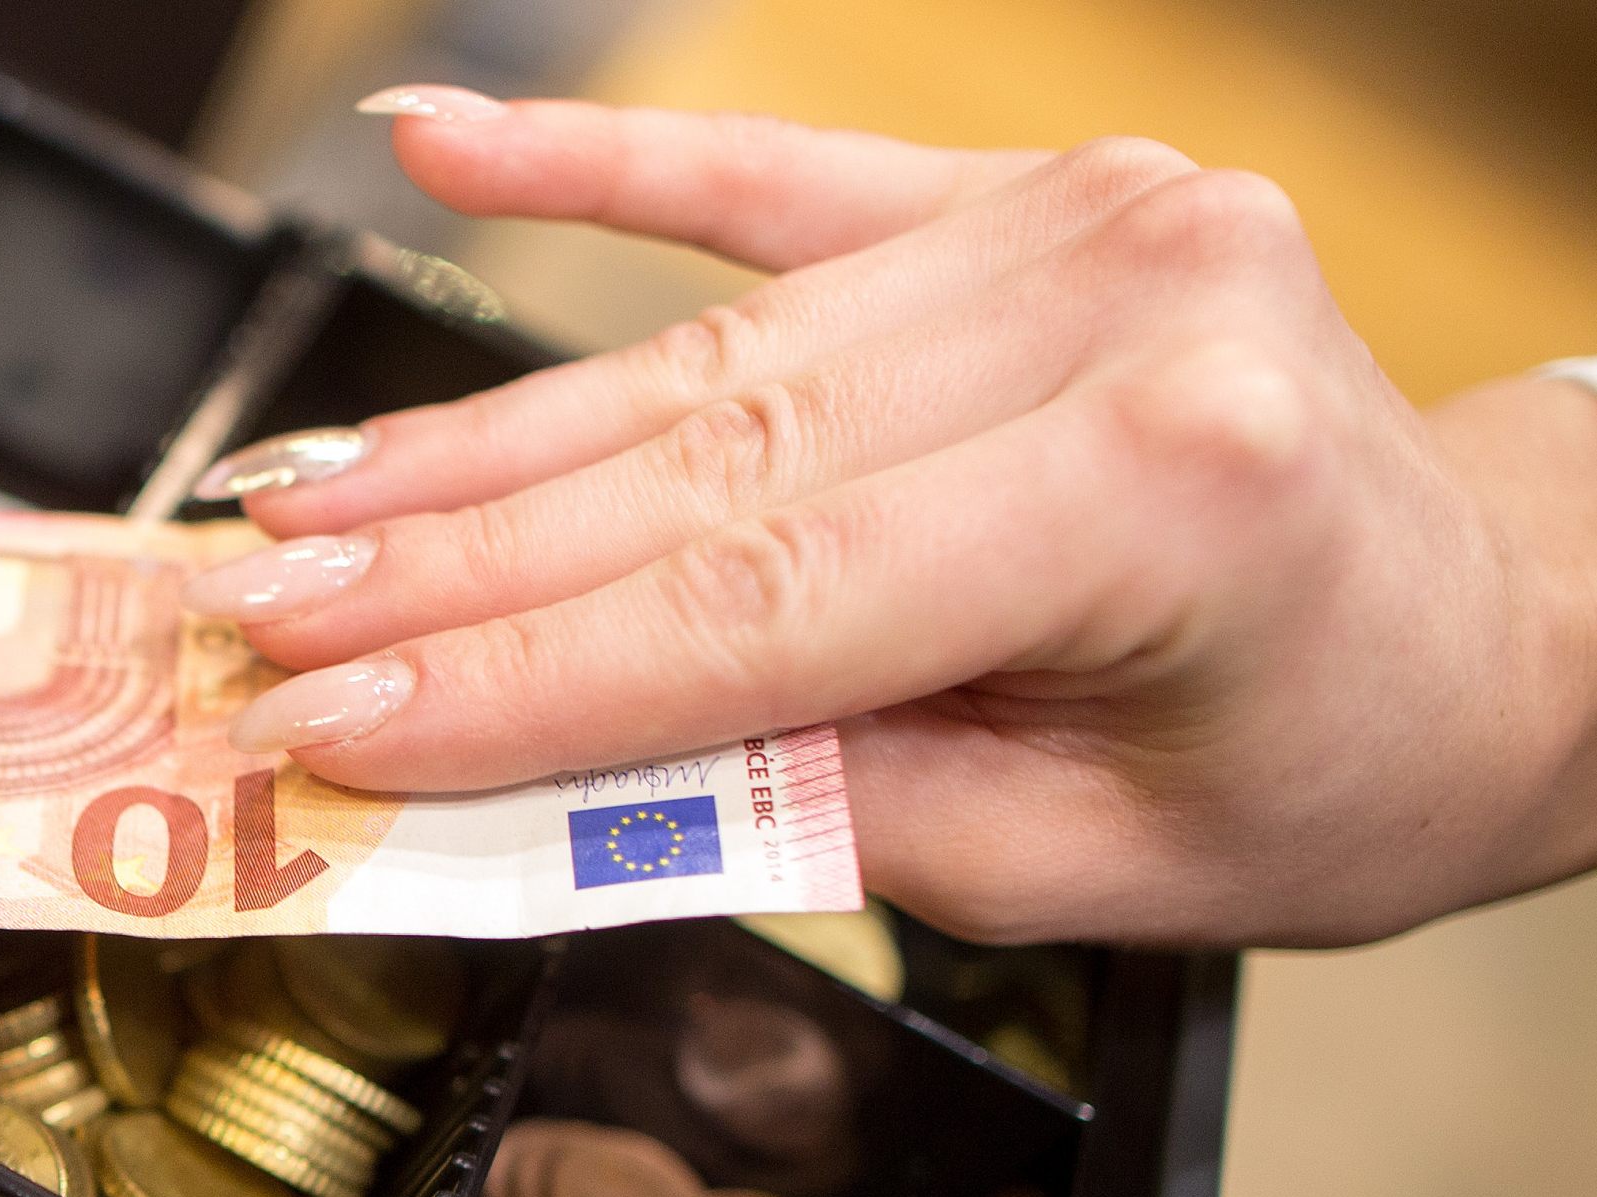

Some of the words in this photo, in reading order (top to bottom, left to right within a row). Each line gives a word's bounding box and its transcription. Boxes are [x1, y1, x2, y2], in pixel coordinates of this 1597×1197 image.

[71, 768, 330, 917] 10
[750, 787, 776, 830] EBC
[763, 840, 783, 883] 2014
